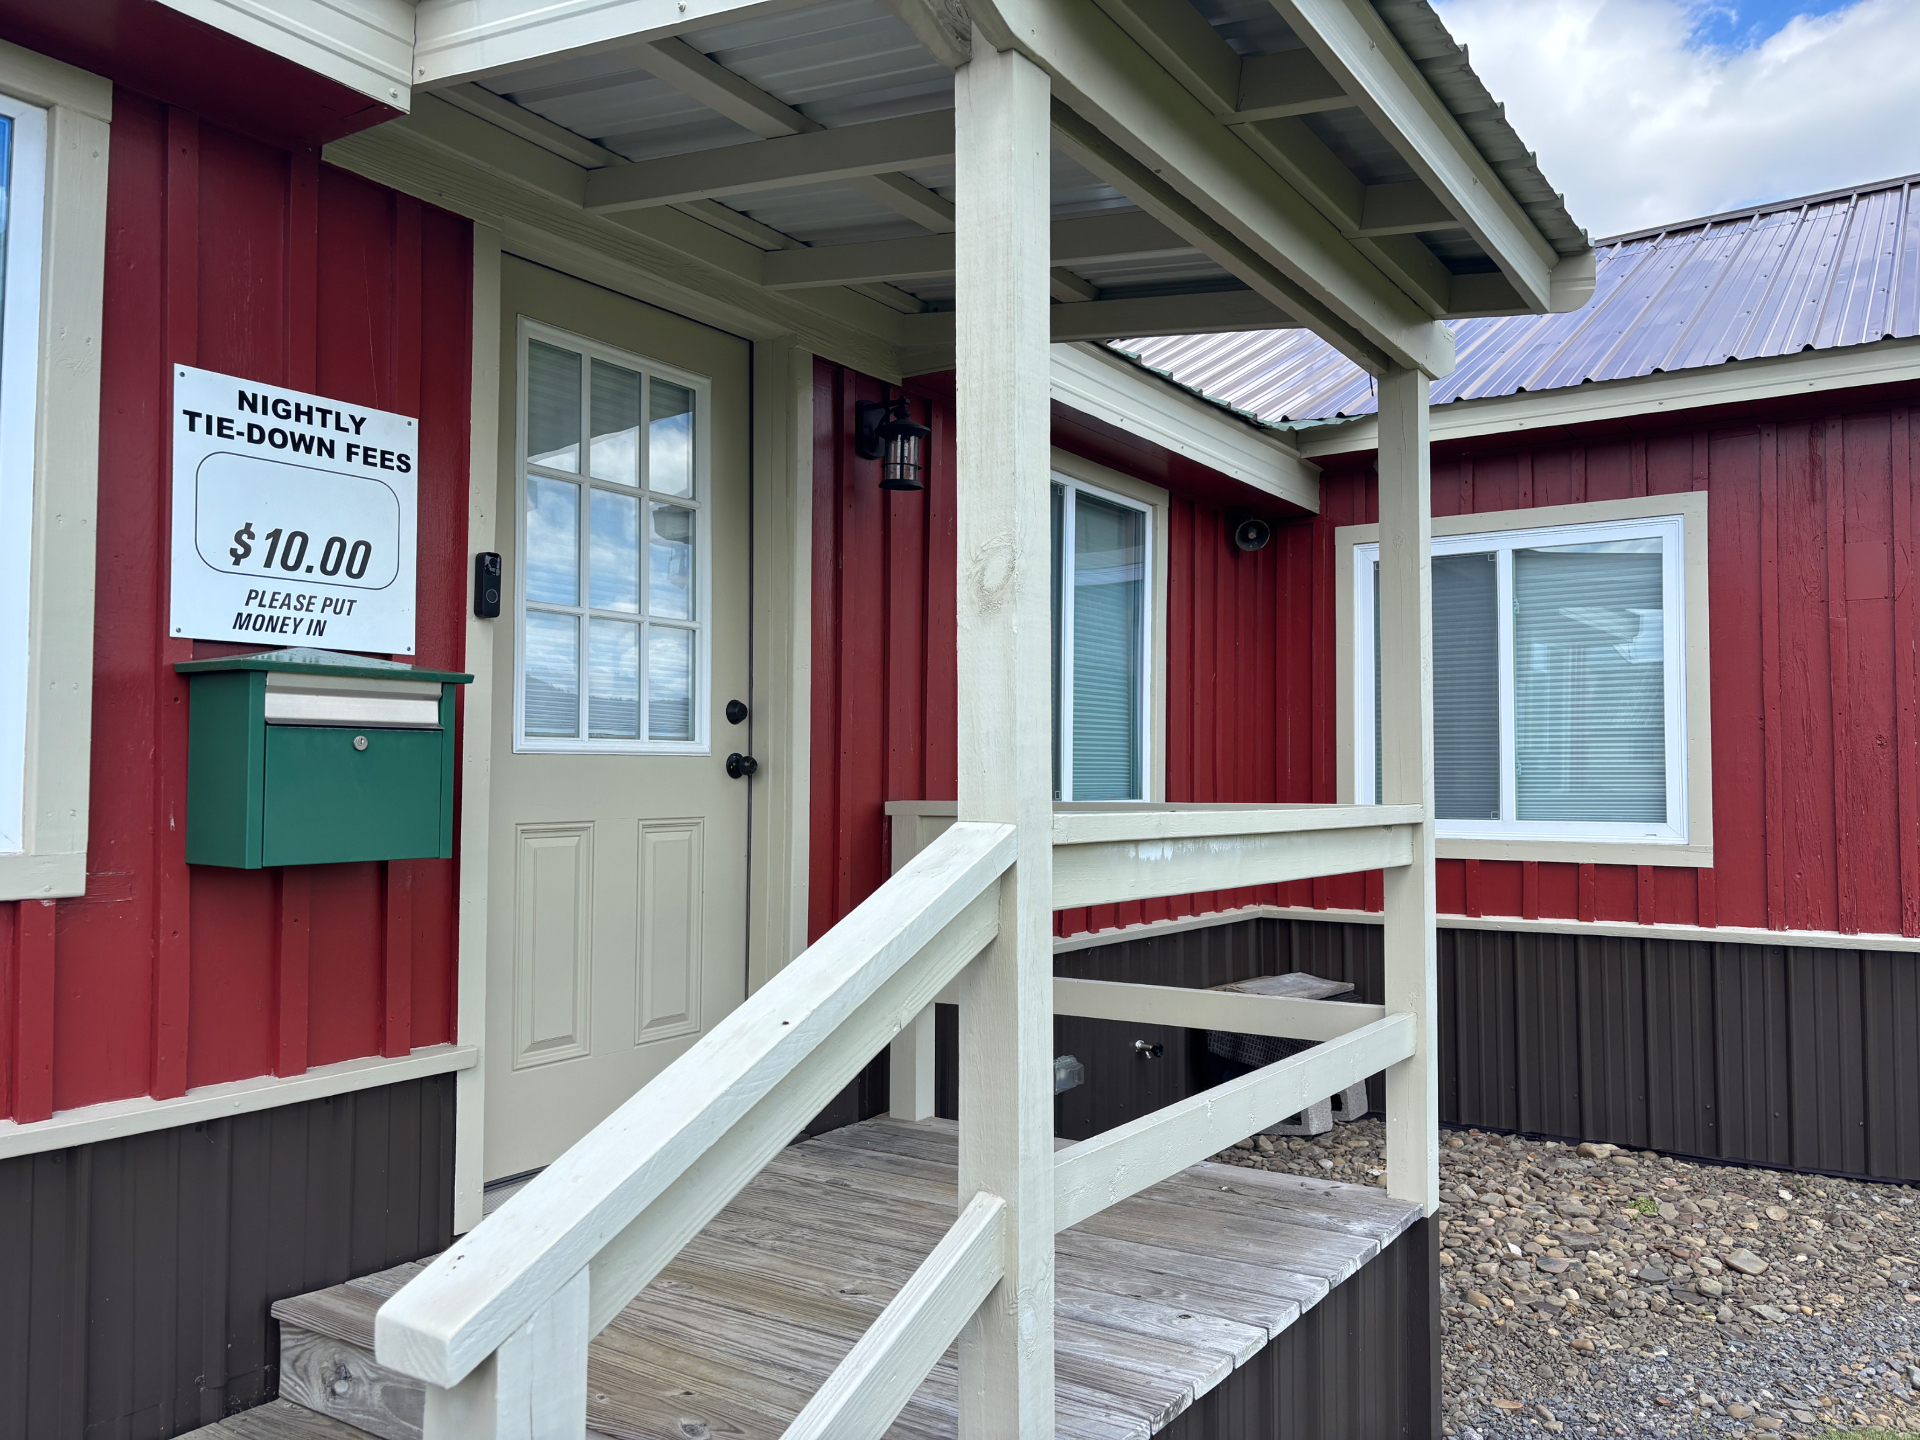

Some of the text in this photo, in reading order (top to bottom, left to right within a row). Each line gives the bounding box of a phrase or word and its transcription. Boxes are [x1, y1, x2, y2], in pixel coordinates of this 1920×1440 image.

[238, 389, 367, 435] NIGHTLY
[182, 409, 412, 473] TIE-DOWN FEES
[228, 522, 372, 580] $10.00
[232, 612, 328, 637] MONEY IN
[244, 588, 358, 616] PLEASE PUT
